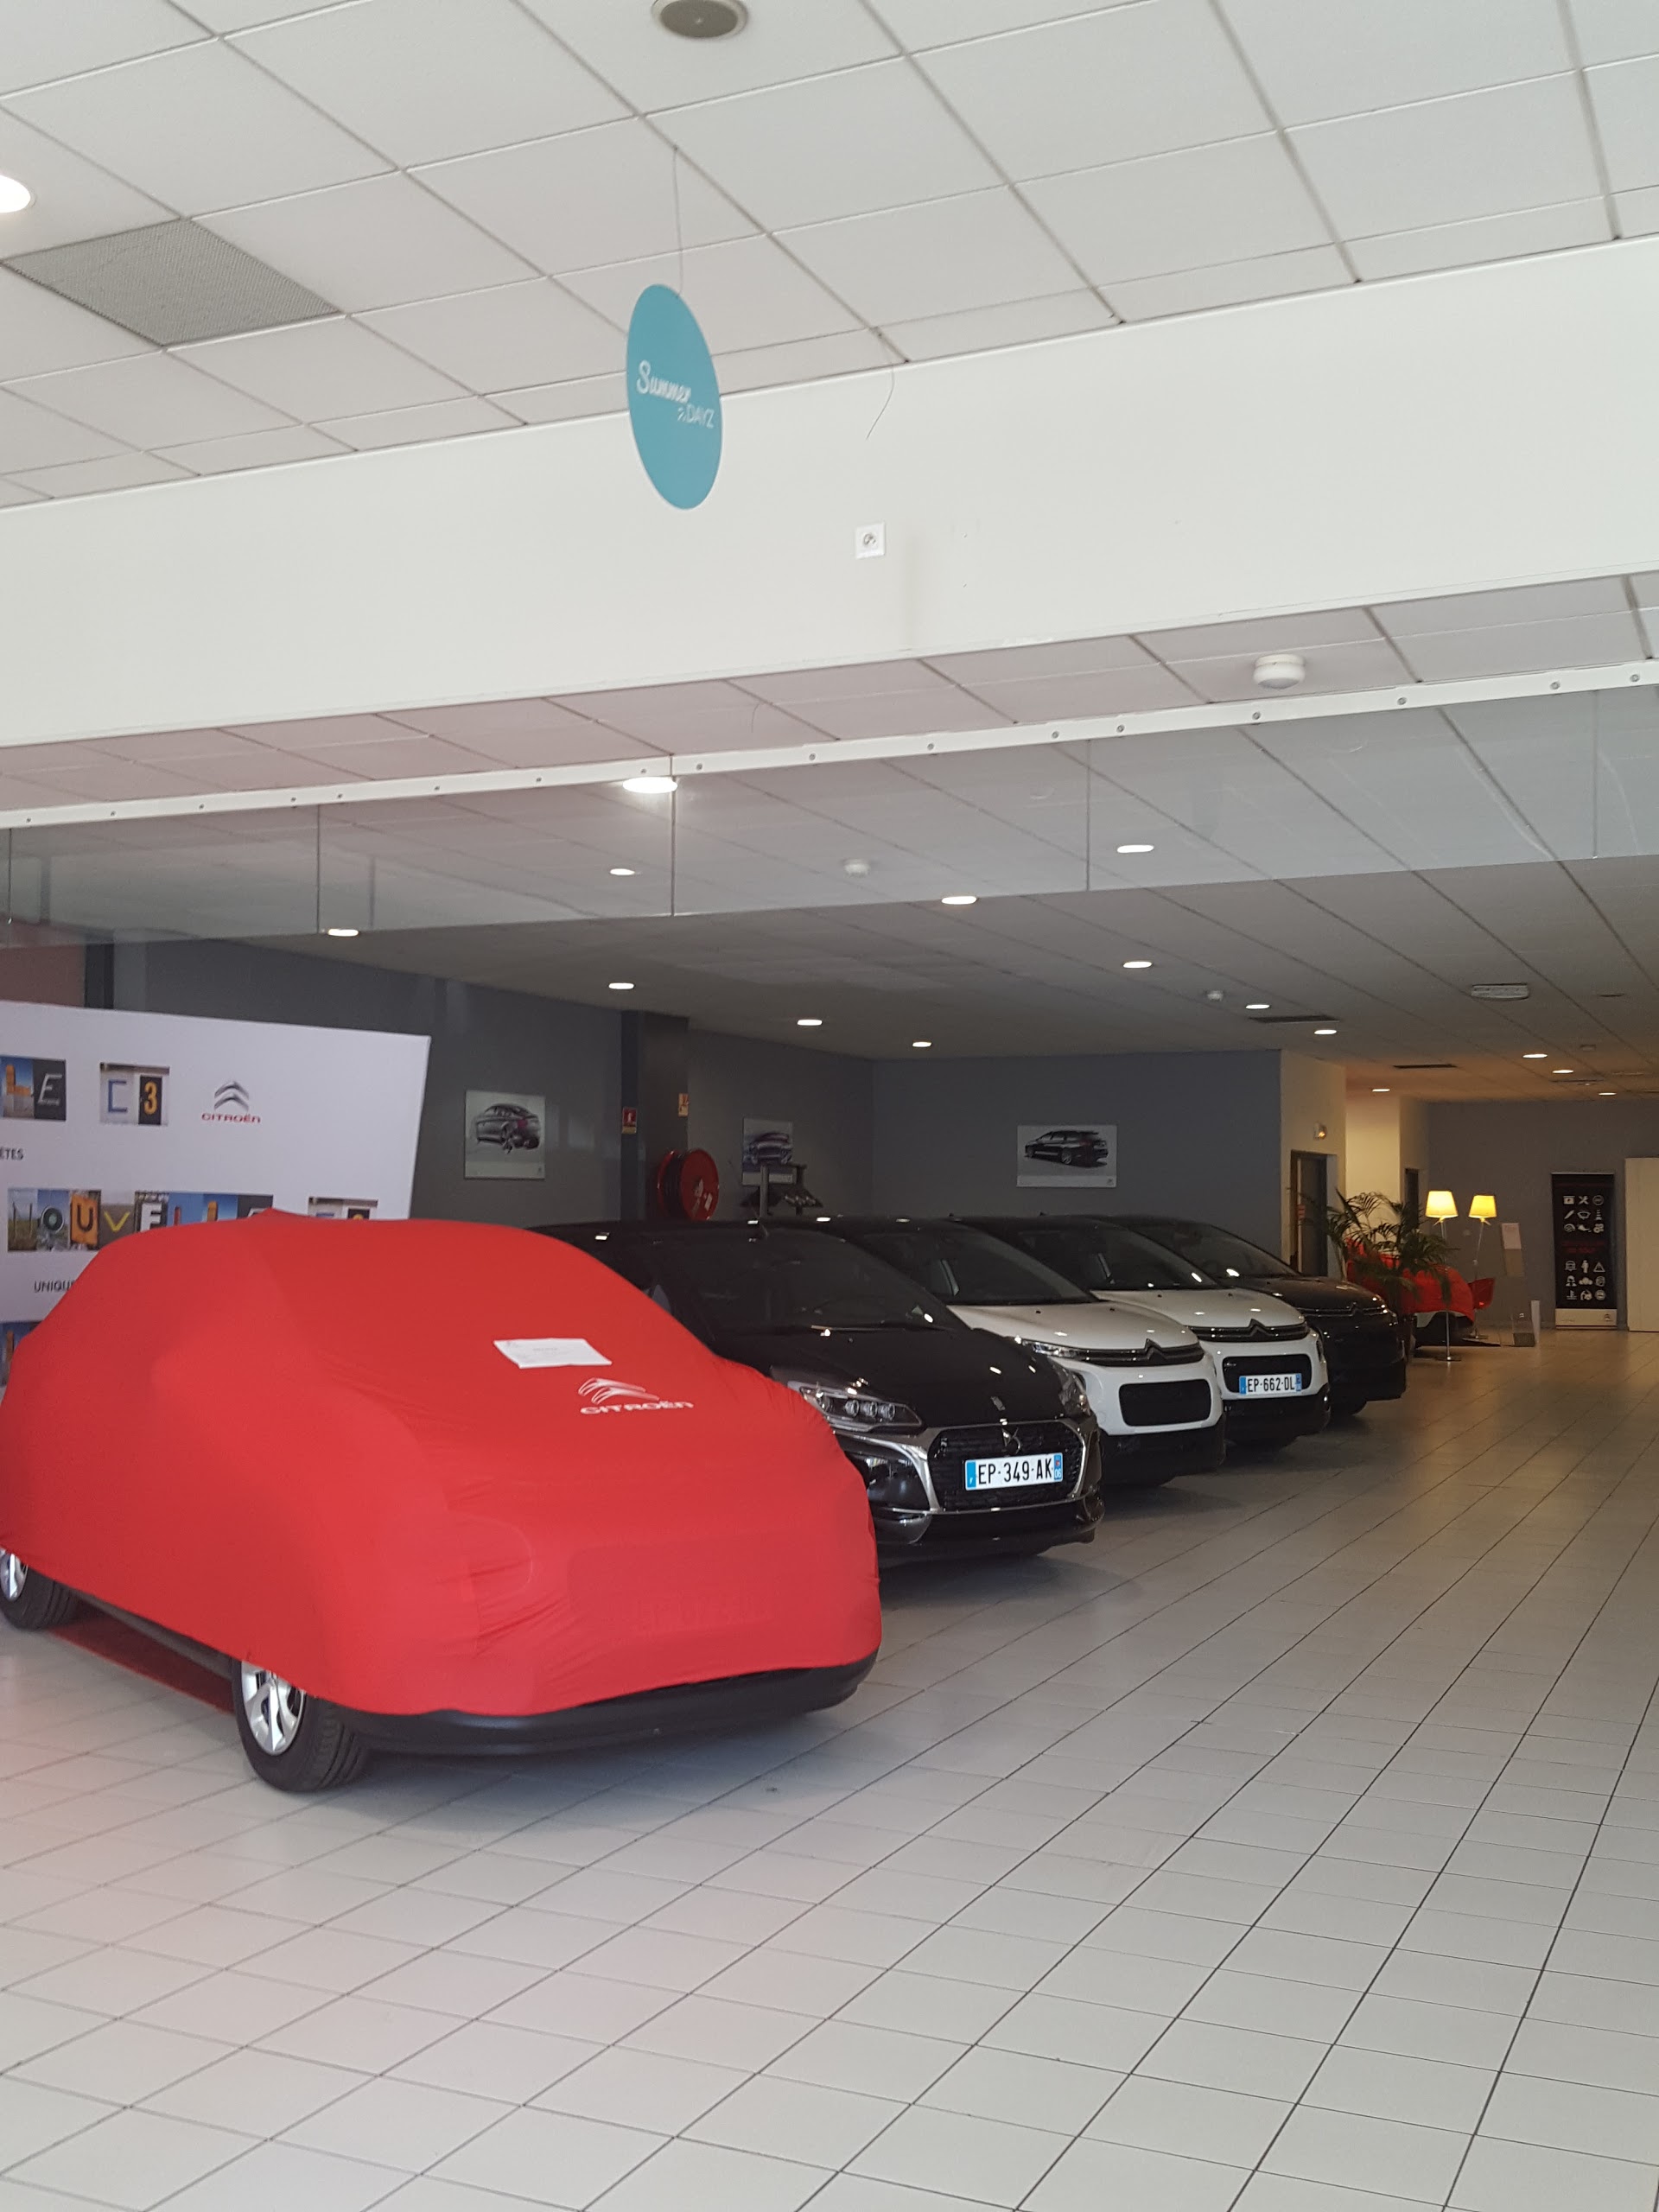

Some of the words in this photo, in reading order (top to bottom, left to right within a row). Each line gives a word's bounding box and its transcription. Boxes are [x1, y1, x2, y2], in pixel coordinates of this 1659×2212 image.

[636, 359, 691, 404] Summer
[105, 1076, 162, 1121] C3
[978, 1458, 1052, 1484] EP-349-AK
